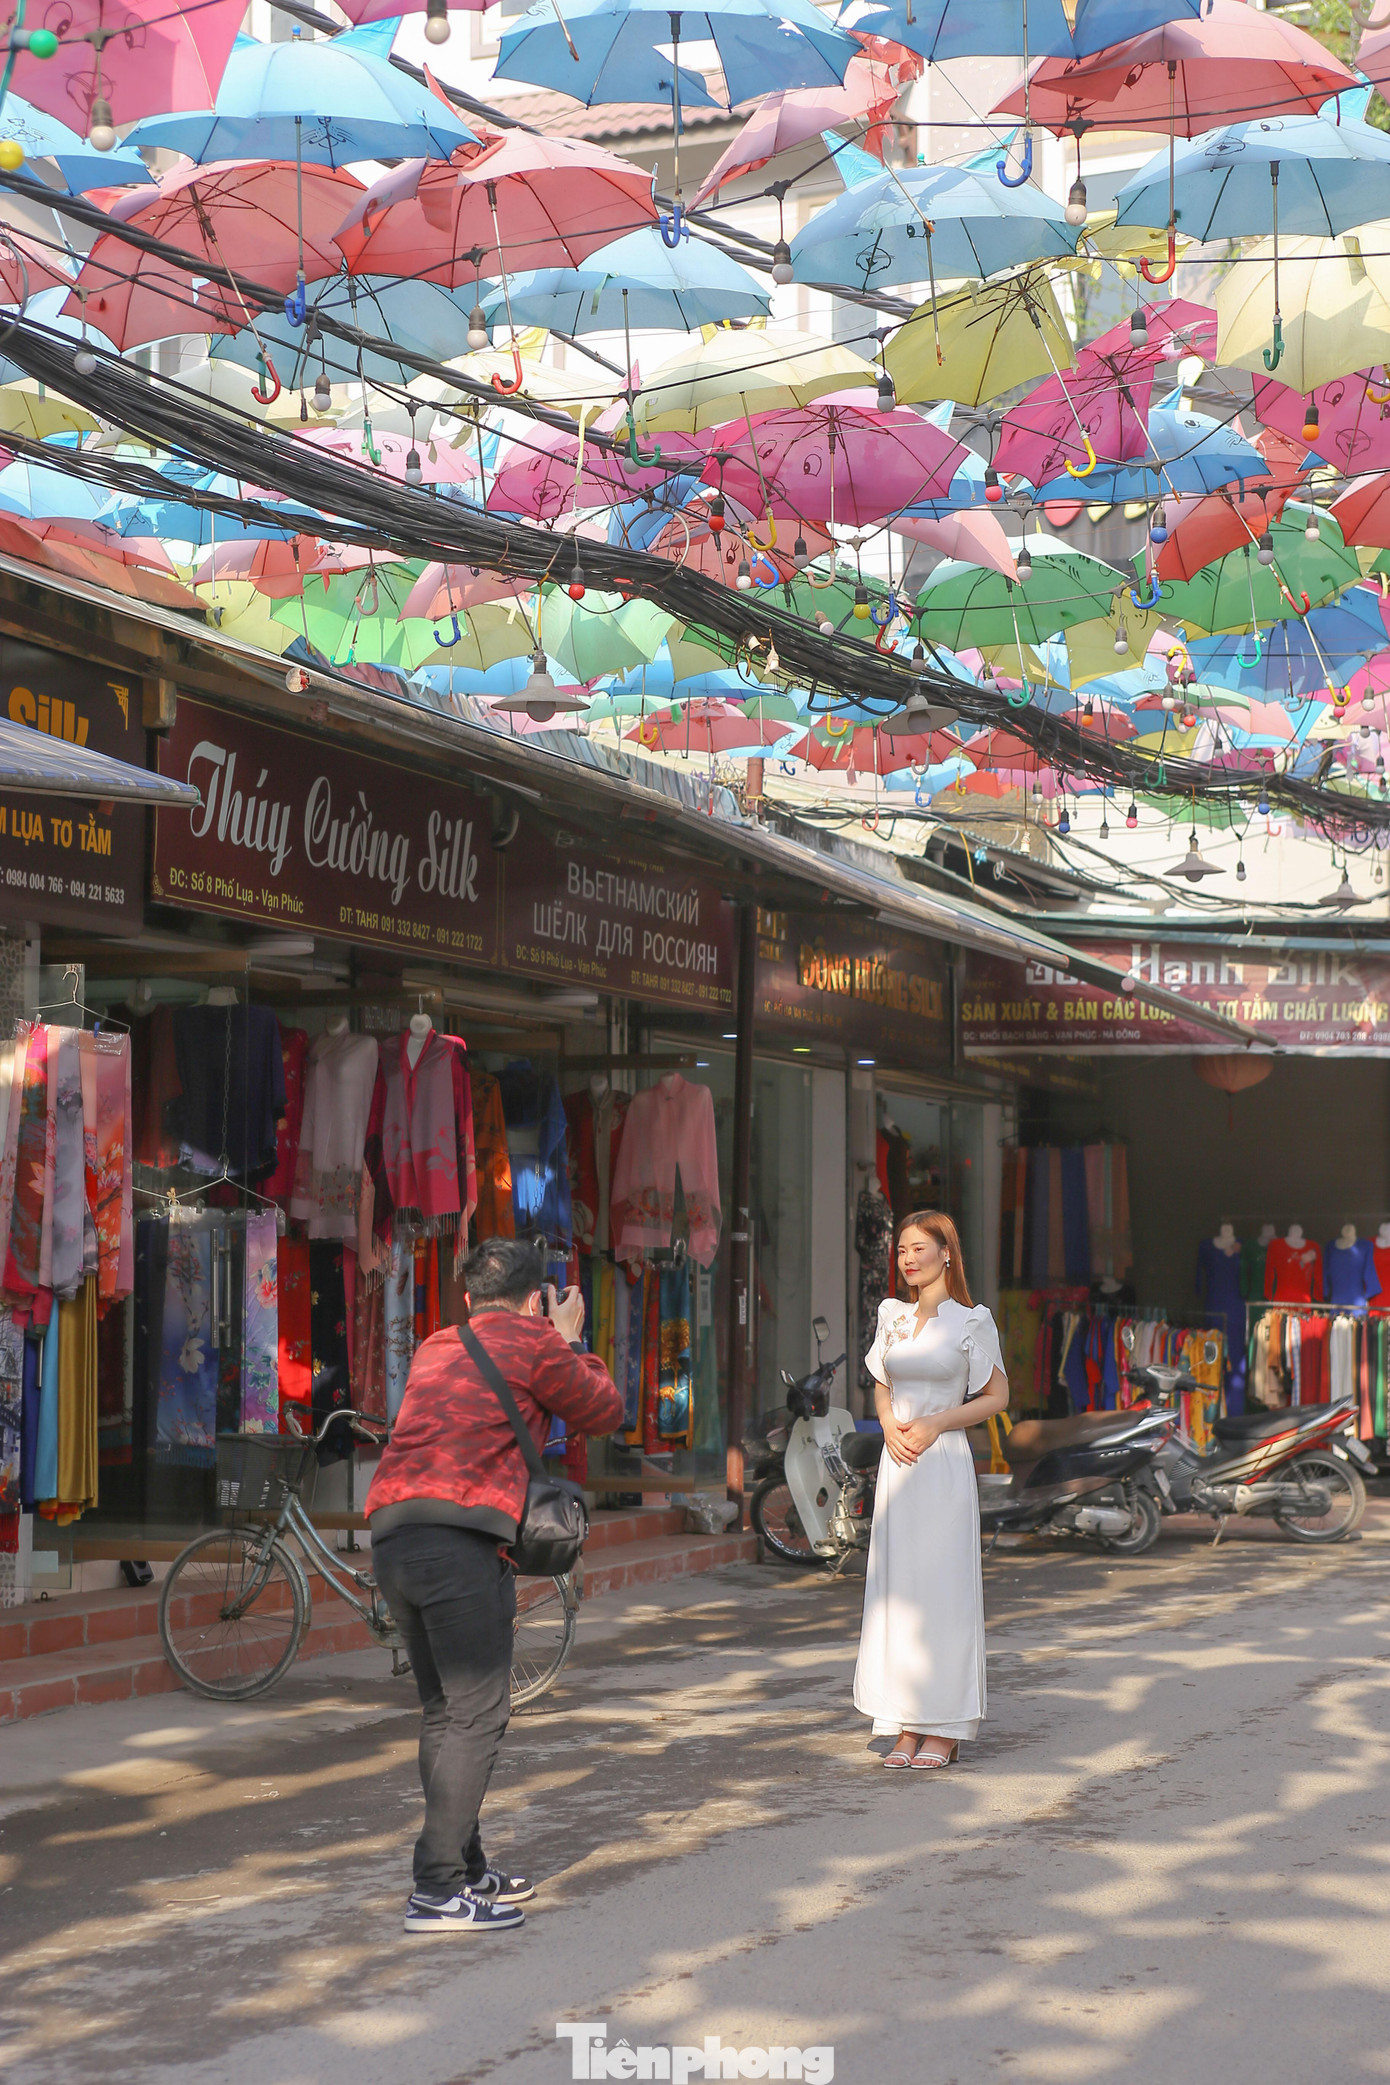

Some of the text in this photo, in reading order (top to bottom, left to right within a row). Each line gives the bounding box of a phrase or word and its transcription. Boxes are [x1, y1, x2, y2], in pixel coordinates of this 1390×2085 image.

[12, 809, 44, 846] LỤA
[51, 818, 73, 848] TƠ
[78, 812, 112, 856] TẰM
[187, 740, 479, 906] Thúy Cường Silk
[6, 868, 27, 888] 0984
[29, 872, 45, 891] 004
[48, 875, 63, 894] 766
[70, 880, 86, 899] 094
[88, 883, 102, 901] 221
[104, 886, 125, 905] 5633
[169, 866, 188, 889] ĐC:
[190, 870, 205, 892] Số
[206, 875, 213, 894] 8
[214, 876, 235, 899] Phố
[235, 882, 253, 907] Lụa
[261, 888, 279, 913] Vạn
[281, 892, 304, 914] Phúc
[567, 861, 699, 927] ВЬЕТНАМСКИЙ
[381, 915, 395, 934] 091
[397, 919, 411, 937] 332
[412, 922, 430, 941] 8427
[437, 927, 450, 945] 091
[451, 930, 465, 948] 222
[466, 933, 483, 951] 1722
[533, 899, 718, 975] ШЁЛК ДЛЯ РОССИЯН
[1129, 944, 1244, 992] Hạnh
[1267, 948, 1360, 985] Silk
[961, 994, 996, 1021] SẢN
[1001, 995, 1041, 1021] XUẤT
[1046, 1002, 1058, 1021] &
[1064, 997, 1098, 1020] BÁN
[1102, 996, 1135, 1020] CÁC
[1283, 995, 1327, 1021] CHẤT
